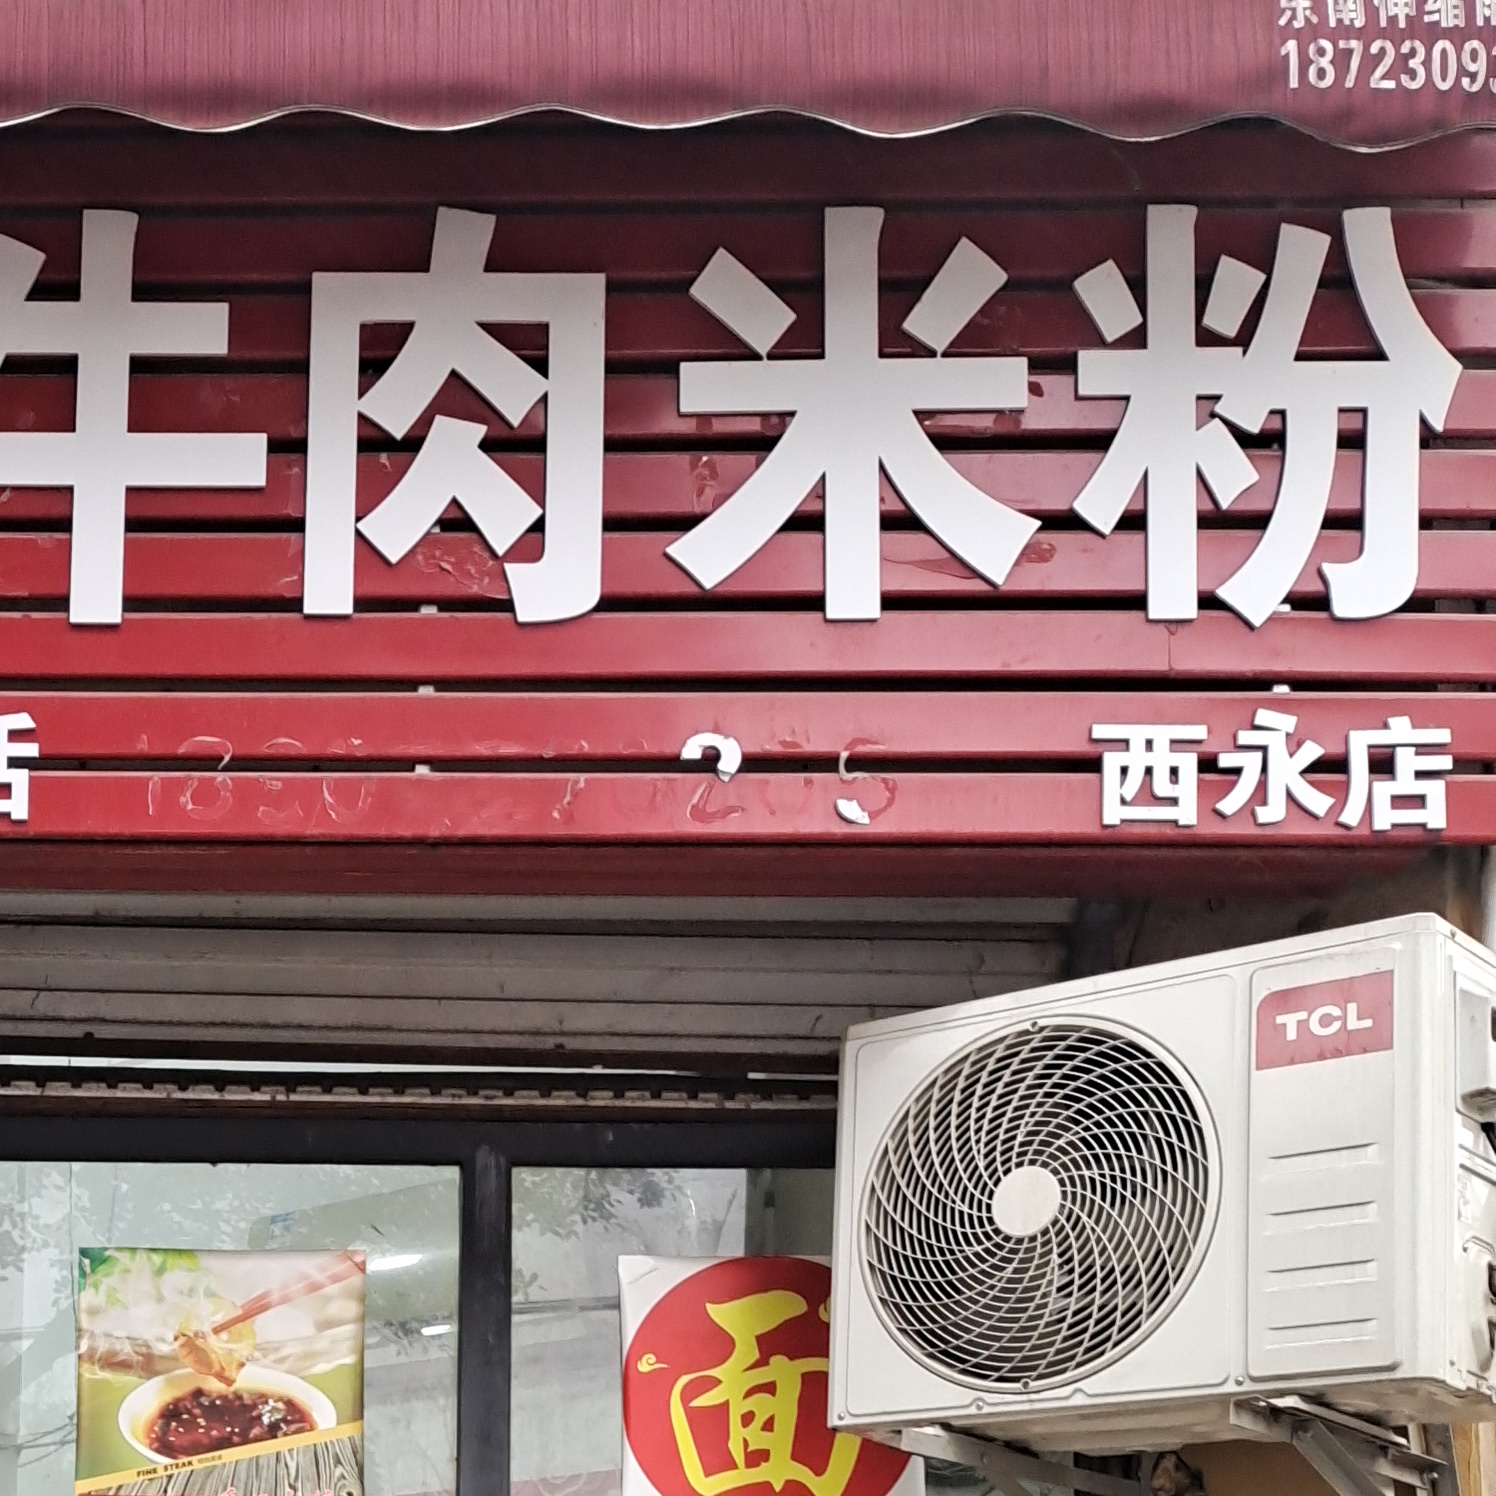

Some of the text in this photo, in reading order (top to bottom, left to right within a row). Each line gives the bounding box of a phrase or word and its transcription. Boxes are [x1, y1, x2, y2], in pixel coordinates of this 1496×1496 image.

[1090, 708, 1454, 832] 西永店
[1275, 1001, 1373, 1042] TCL
